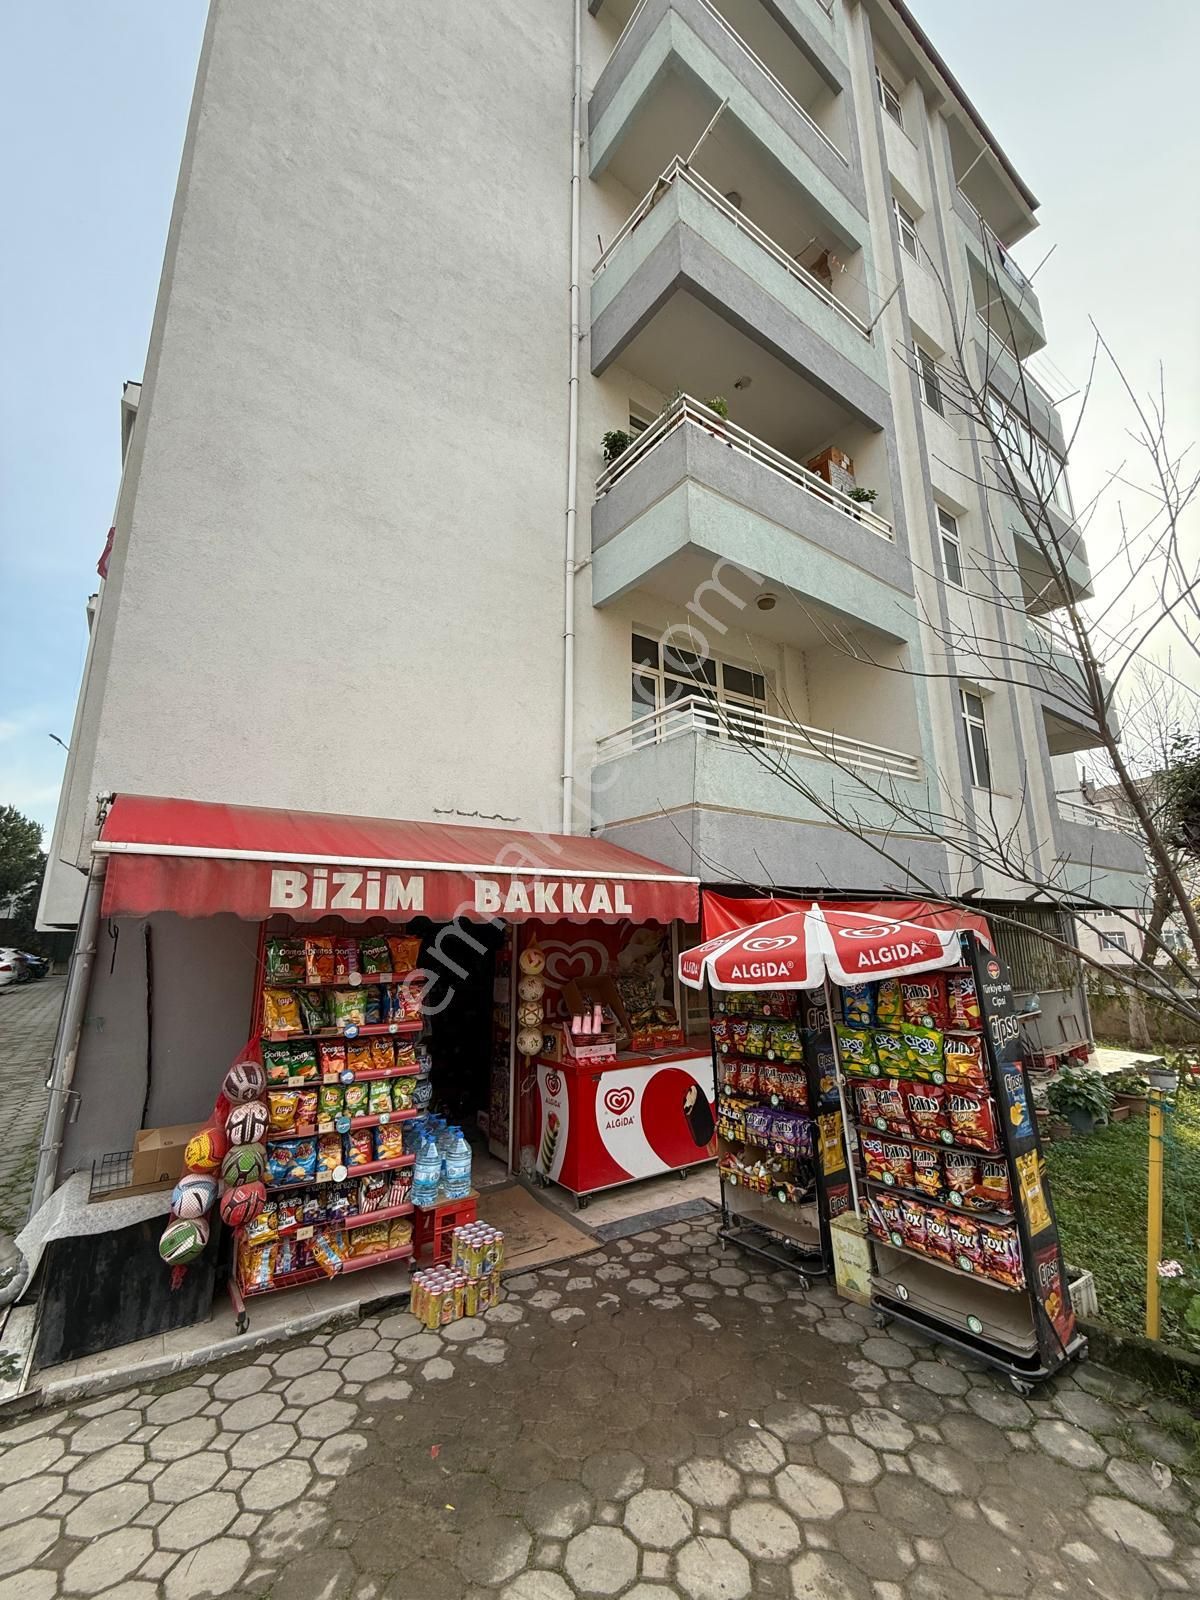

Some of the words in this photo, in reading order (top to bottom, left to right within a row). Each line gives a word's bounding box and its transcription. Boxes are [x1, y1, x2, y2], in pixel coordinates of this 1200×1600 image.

[474, 879, 634, 915] BAKKAL
[901, 983, 932, 1000] Patos
[807, 1007, 836, 1033] Cips
[908, 1092, 940, 1113] Patos
[925, 1217, 948, 1239] FOX
[950, 1228, 975, 1249] FOX
[980, 1233, 1006, 1254] FOX
